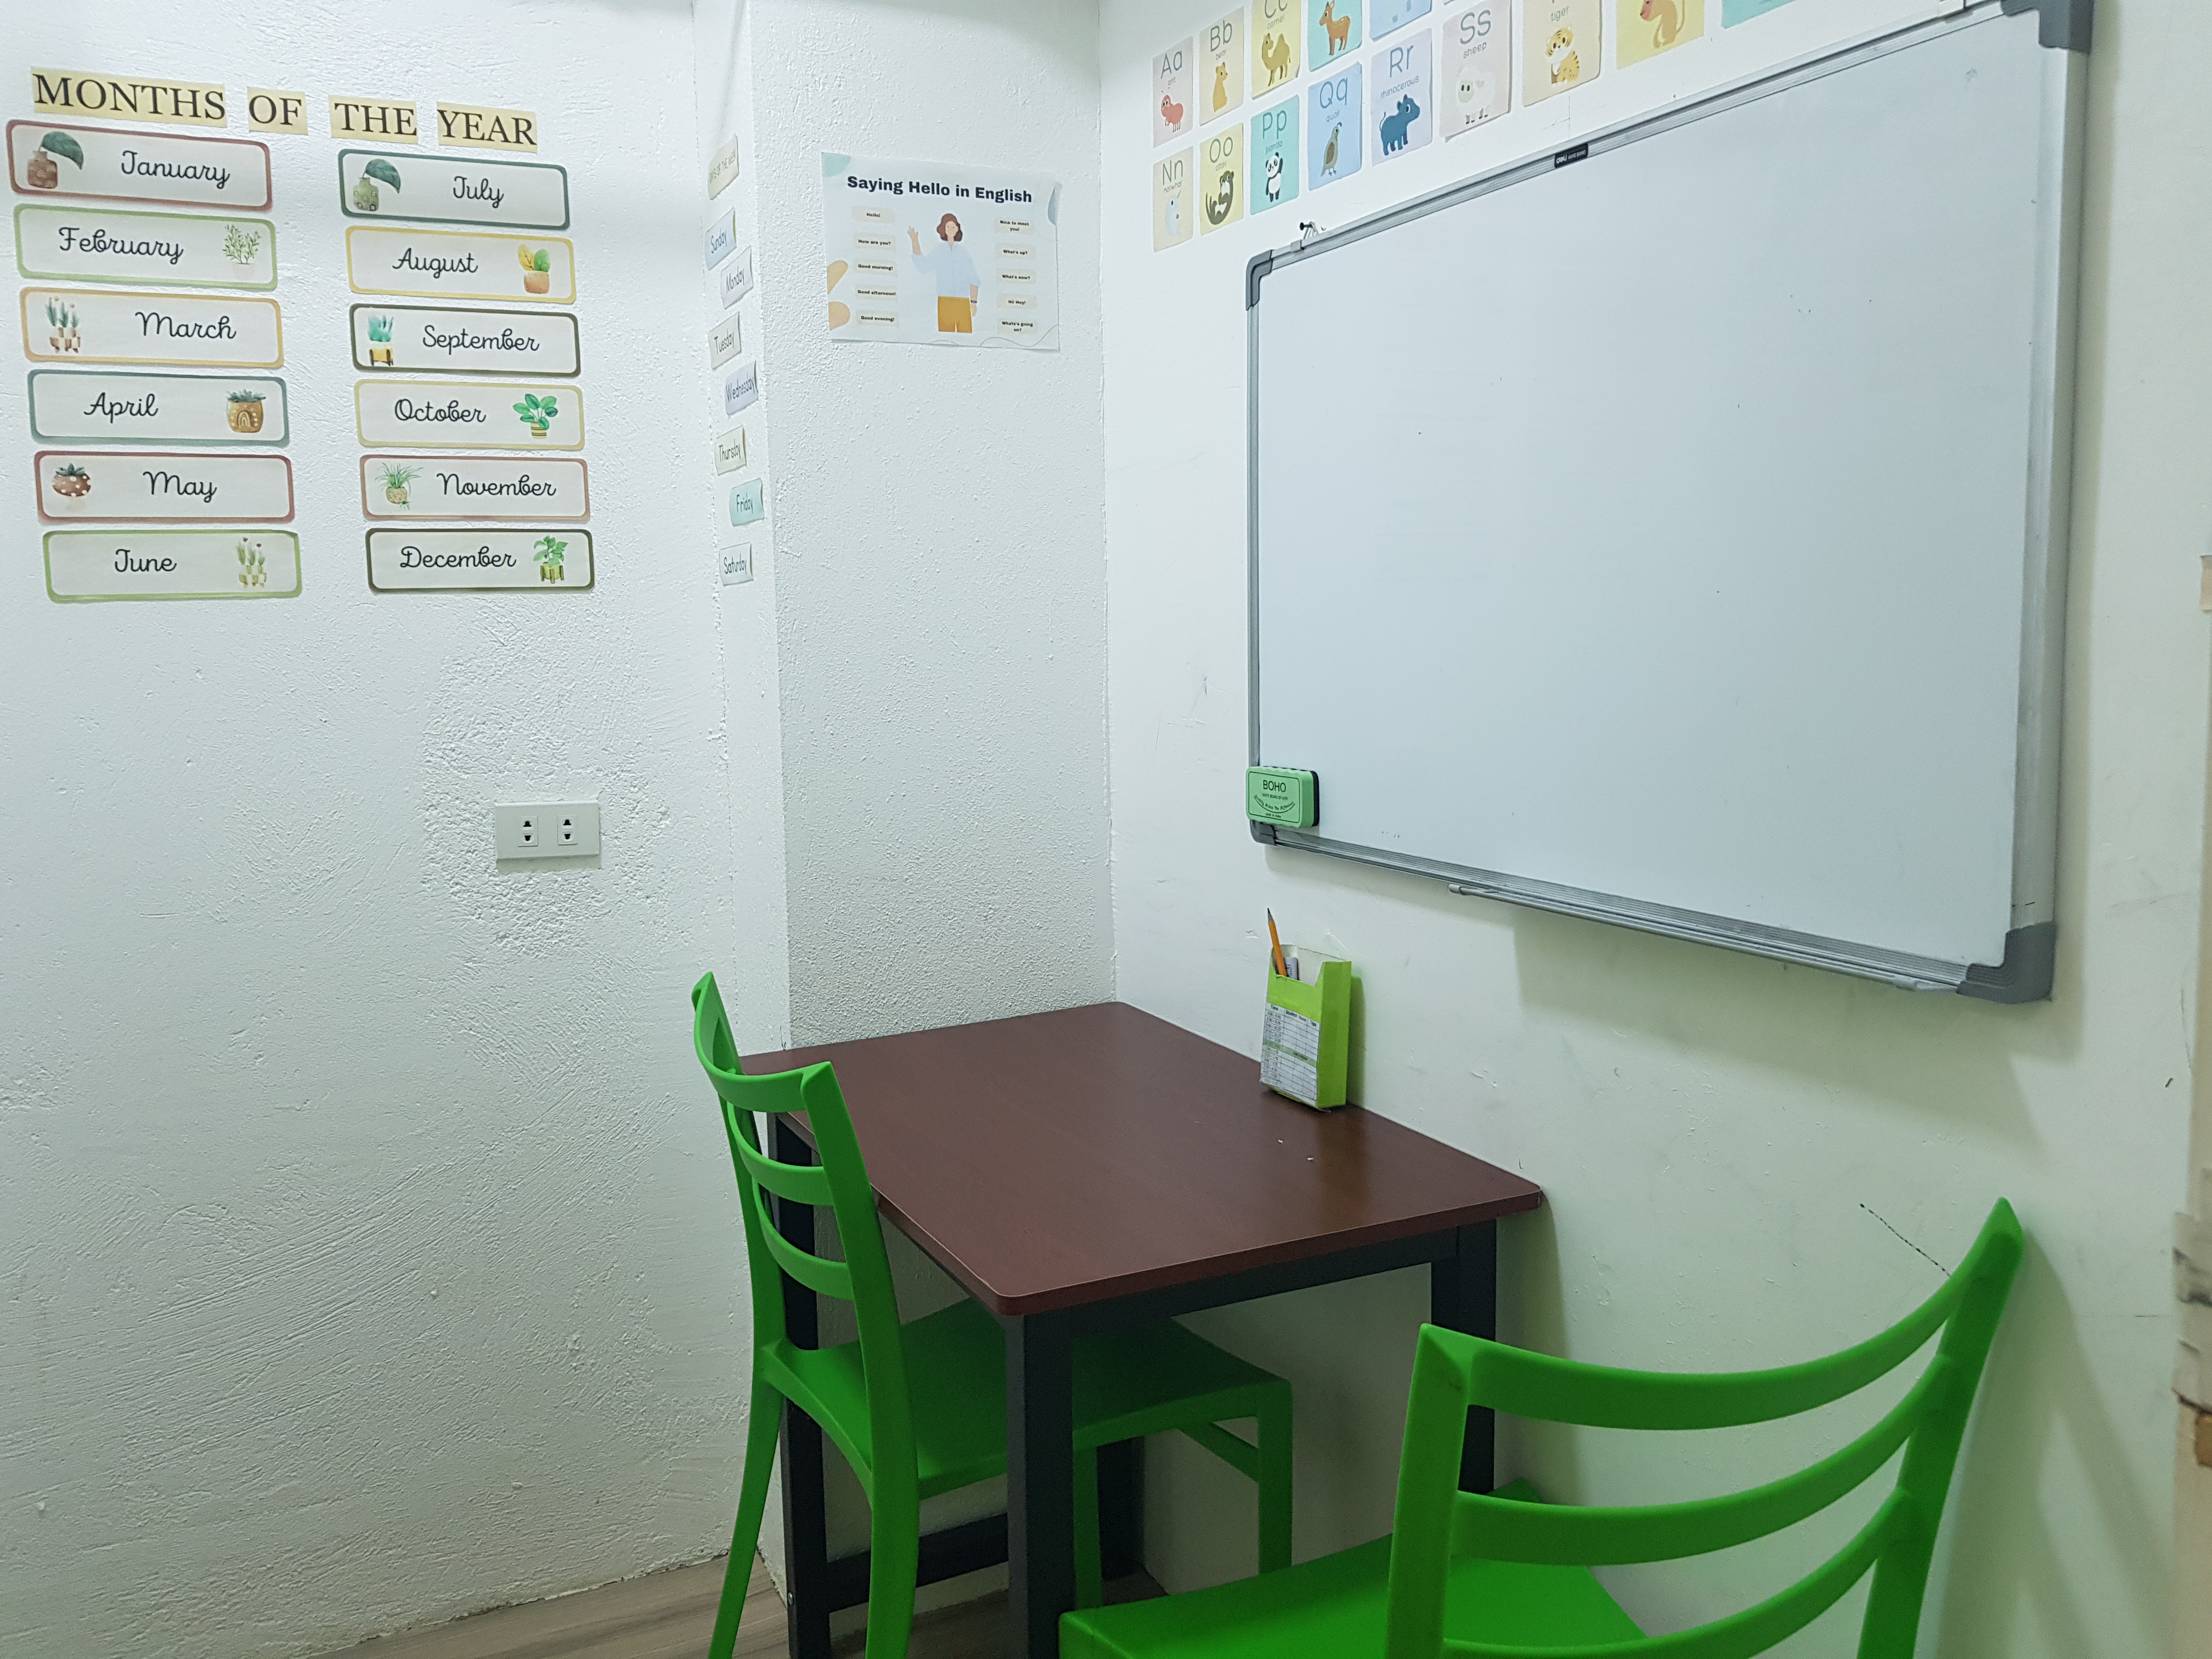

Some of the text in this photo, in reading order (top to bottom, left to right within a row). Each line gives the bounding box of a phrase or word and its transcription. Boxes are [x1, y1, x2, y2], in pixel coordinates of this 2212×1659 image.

[1266, 14, 1285, 30] camel
[1550, 6, 1570, 21] tiger
[1210, 19, 1232, 52] Bb
[1216, 49, 1226, 60] bear
[1390, 45, 1414, 78] Rr
[1463, 42, 1487, 59] sheep
[1161, 50, 1182, 79] Aa
[1167, 77, 1176, 86] ant
[1319, 77, 1348, 109] Qq
[1380, 75, 1419, 99] rhinocerous
[32, 74, 538, 146] MONTHS OF THE YEAR
[1326, 110, 1340, 123] quail
[1262, 110, 1287, 139] Pp
[1209, 137, 1233, 163] Oo
[1266, 140, 1283, 155] panda
[121, 150, 230, 189] January
[1163, 160, 1183, 185] Nn
[1215, 161, 1227, 171] otter
[453, 176, 505, 208] July
[847, 176, 1032, 204] Saying Hello in English
[1163, 181, 1182, 194] narwhal
[58, 227, 184, 264] February
[710, 228, 728, 255] Sunday
[392, 247, 479, 279] August
[726, 266, 745, 295] Monday
[135, 312, 236, 340] March
[422, 324, 540, 355] September
[714, 330, 735, 356] Tuesday
[725, 375, 755, 403] Wednesday
[83, 392, 159, 424] April
[394, 398, 486, 422] October
[719, 438, 741, 462] Thursday
[143, 471, 217, 503] May
[436, 473, 556, 496] November
[736, 494, 753, 514] Friday
[114, 549, 177, 573] June
[399, 546, 517, 568] December
[723, 553, 747, 575] Saturday
[1263, 780, 1286, 793] BOHO
